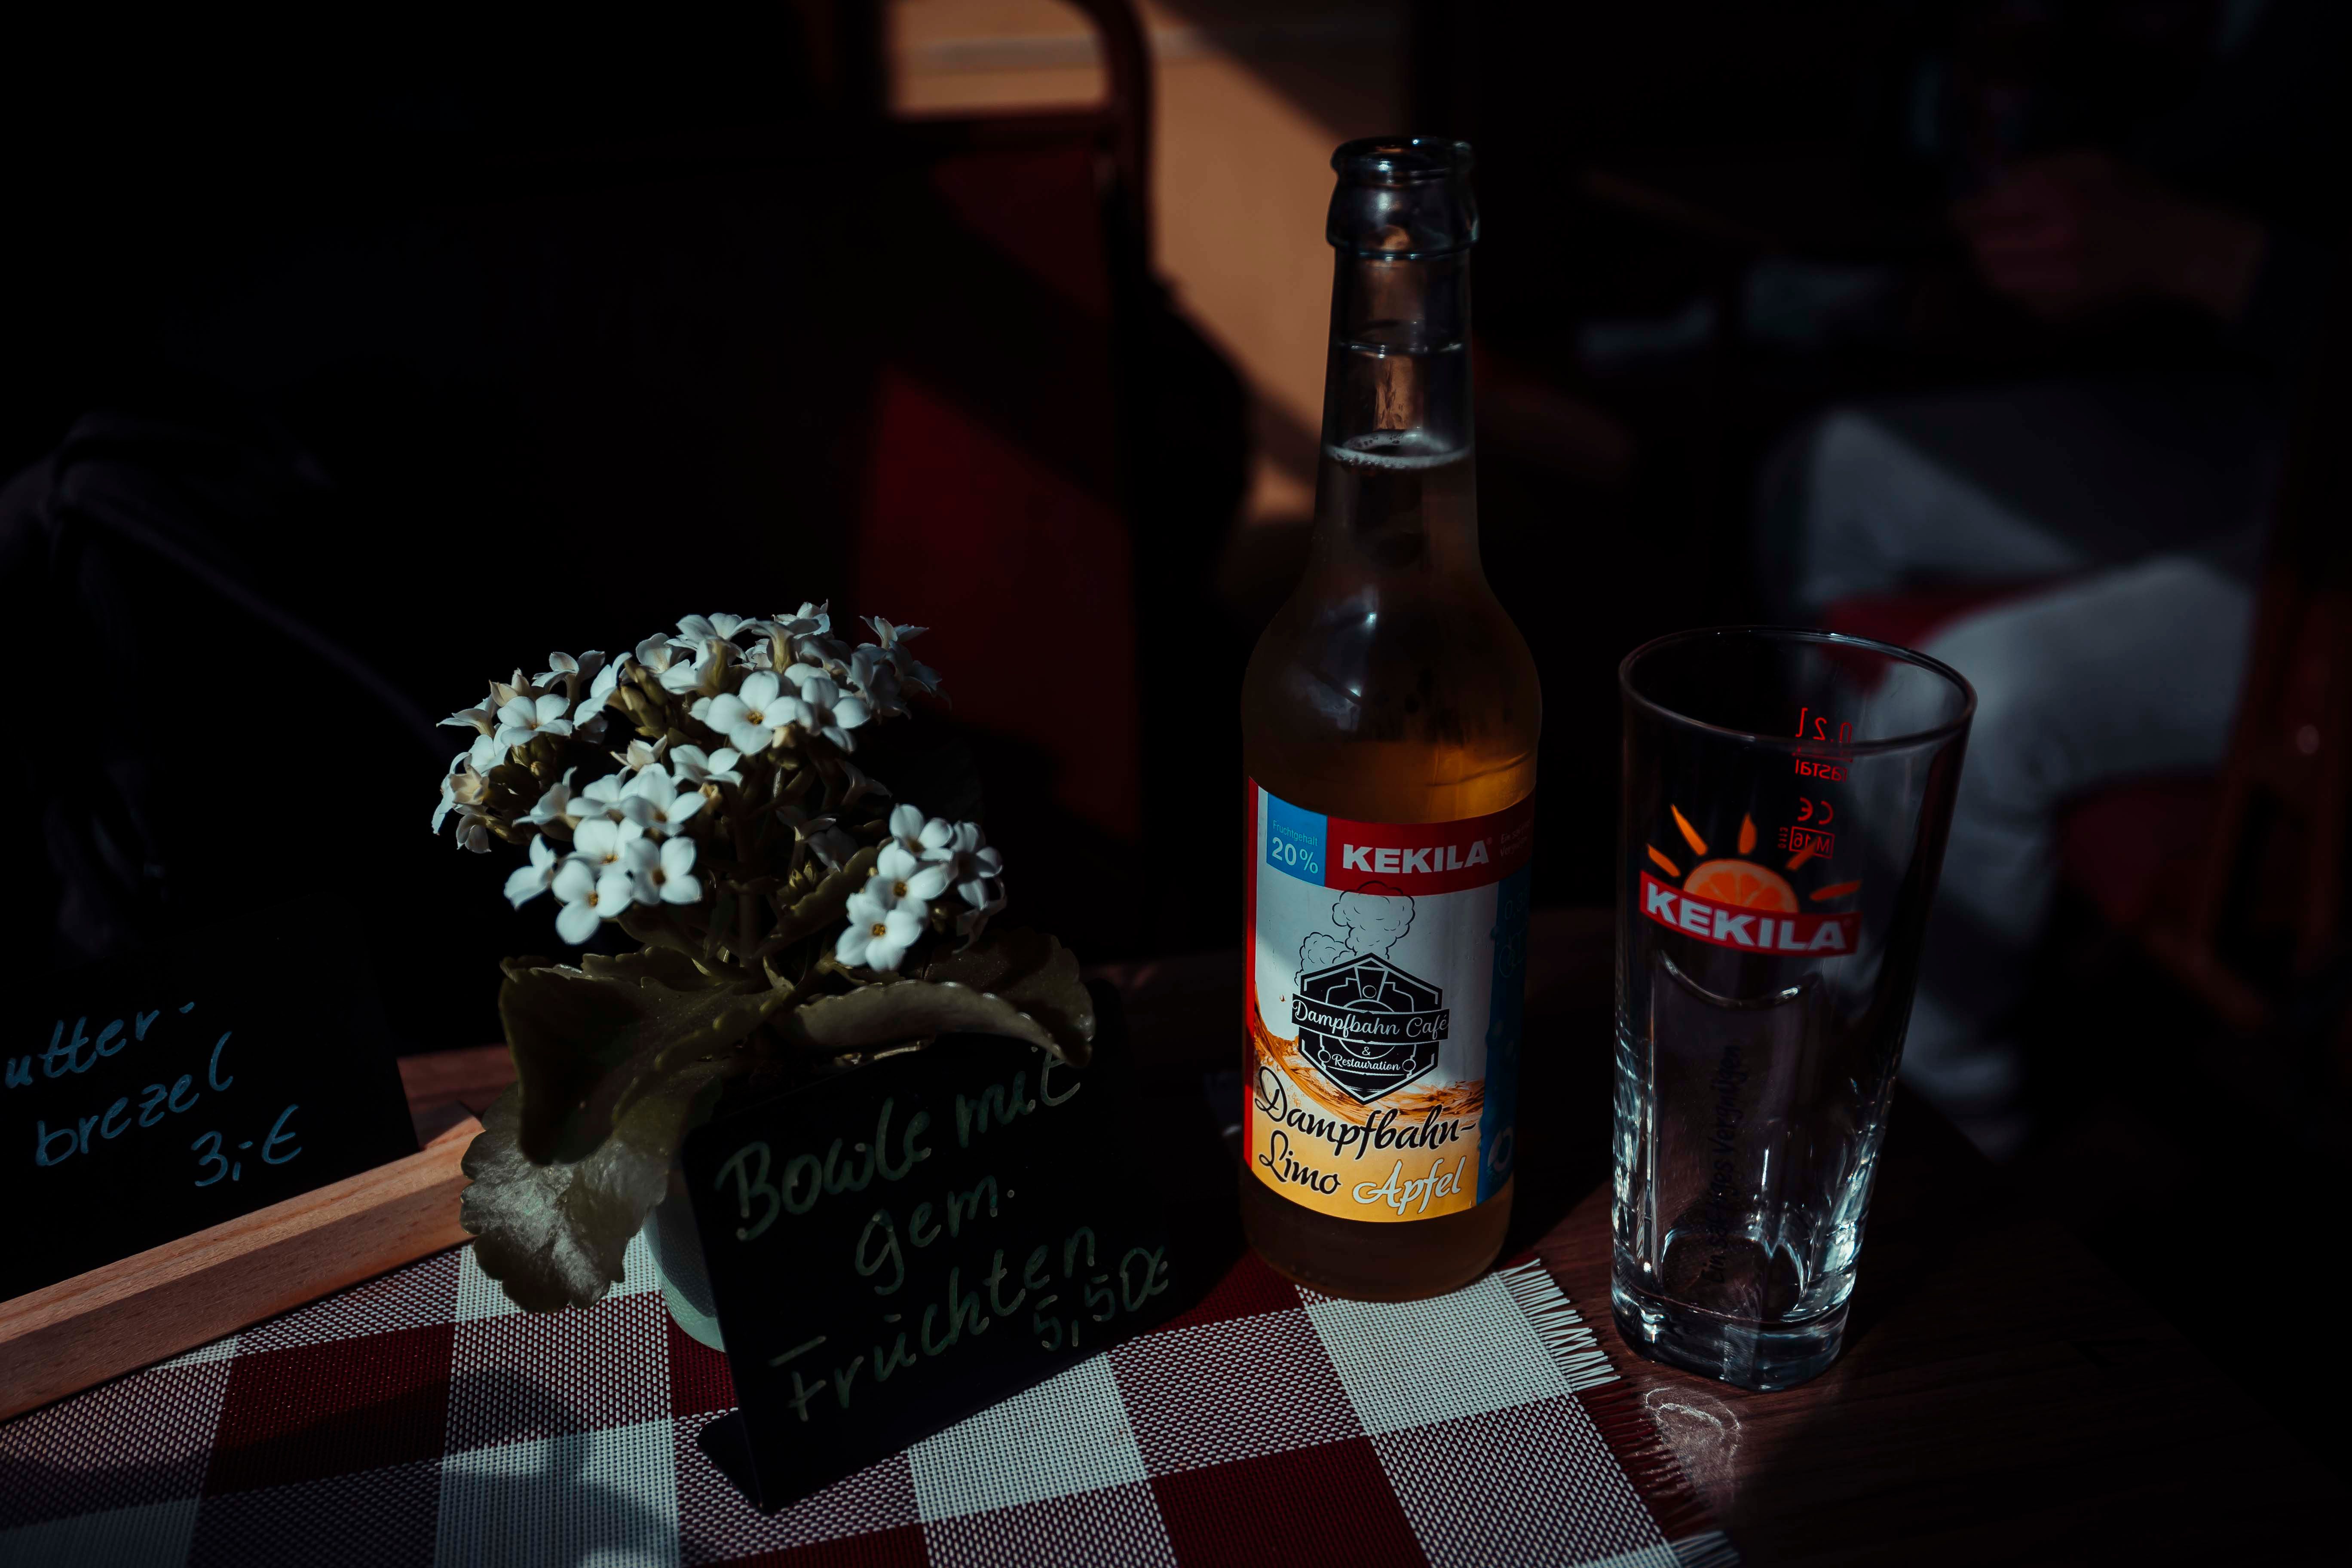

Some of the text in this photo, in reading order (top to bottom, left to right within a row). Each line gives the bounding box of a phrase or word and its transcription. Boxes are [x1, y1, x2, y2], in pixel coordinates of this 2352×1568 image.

[1272, 819, 1319, 847] Fruchtgehalt
[1272, 836, 1319, 874] 20%
[1342, 839, 1489, 874] KEKILA
[1647, 881, 1847, 950] KEKILA
[1292, 998, 1449, 1038] Dampfbahn Café
[1361, 1046, 1371, 1056] &
[34, 1031, 234, 1168] brezel
[1332, 1054, 1400, 1072] Restauration
[714, 1046, 1081, 1242] Bowle mit
[1254, 1066, 1477, 1160] Dampfbahn-
[1259, 1130, 1341, 1195] Limo
[1352, 1155, 1467, 1216] Apfel
[855, 1174, 1016, 1295] gem.
[768, 1226, 1096, 1422] Früchten
[1032, 1245, 1170, 1351] 5,50€
